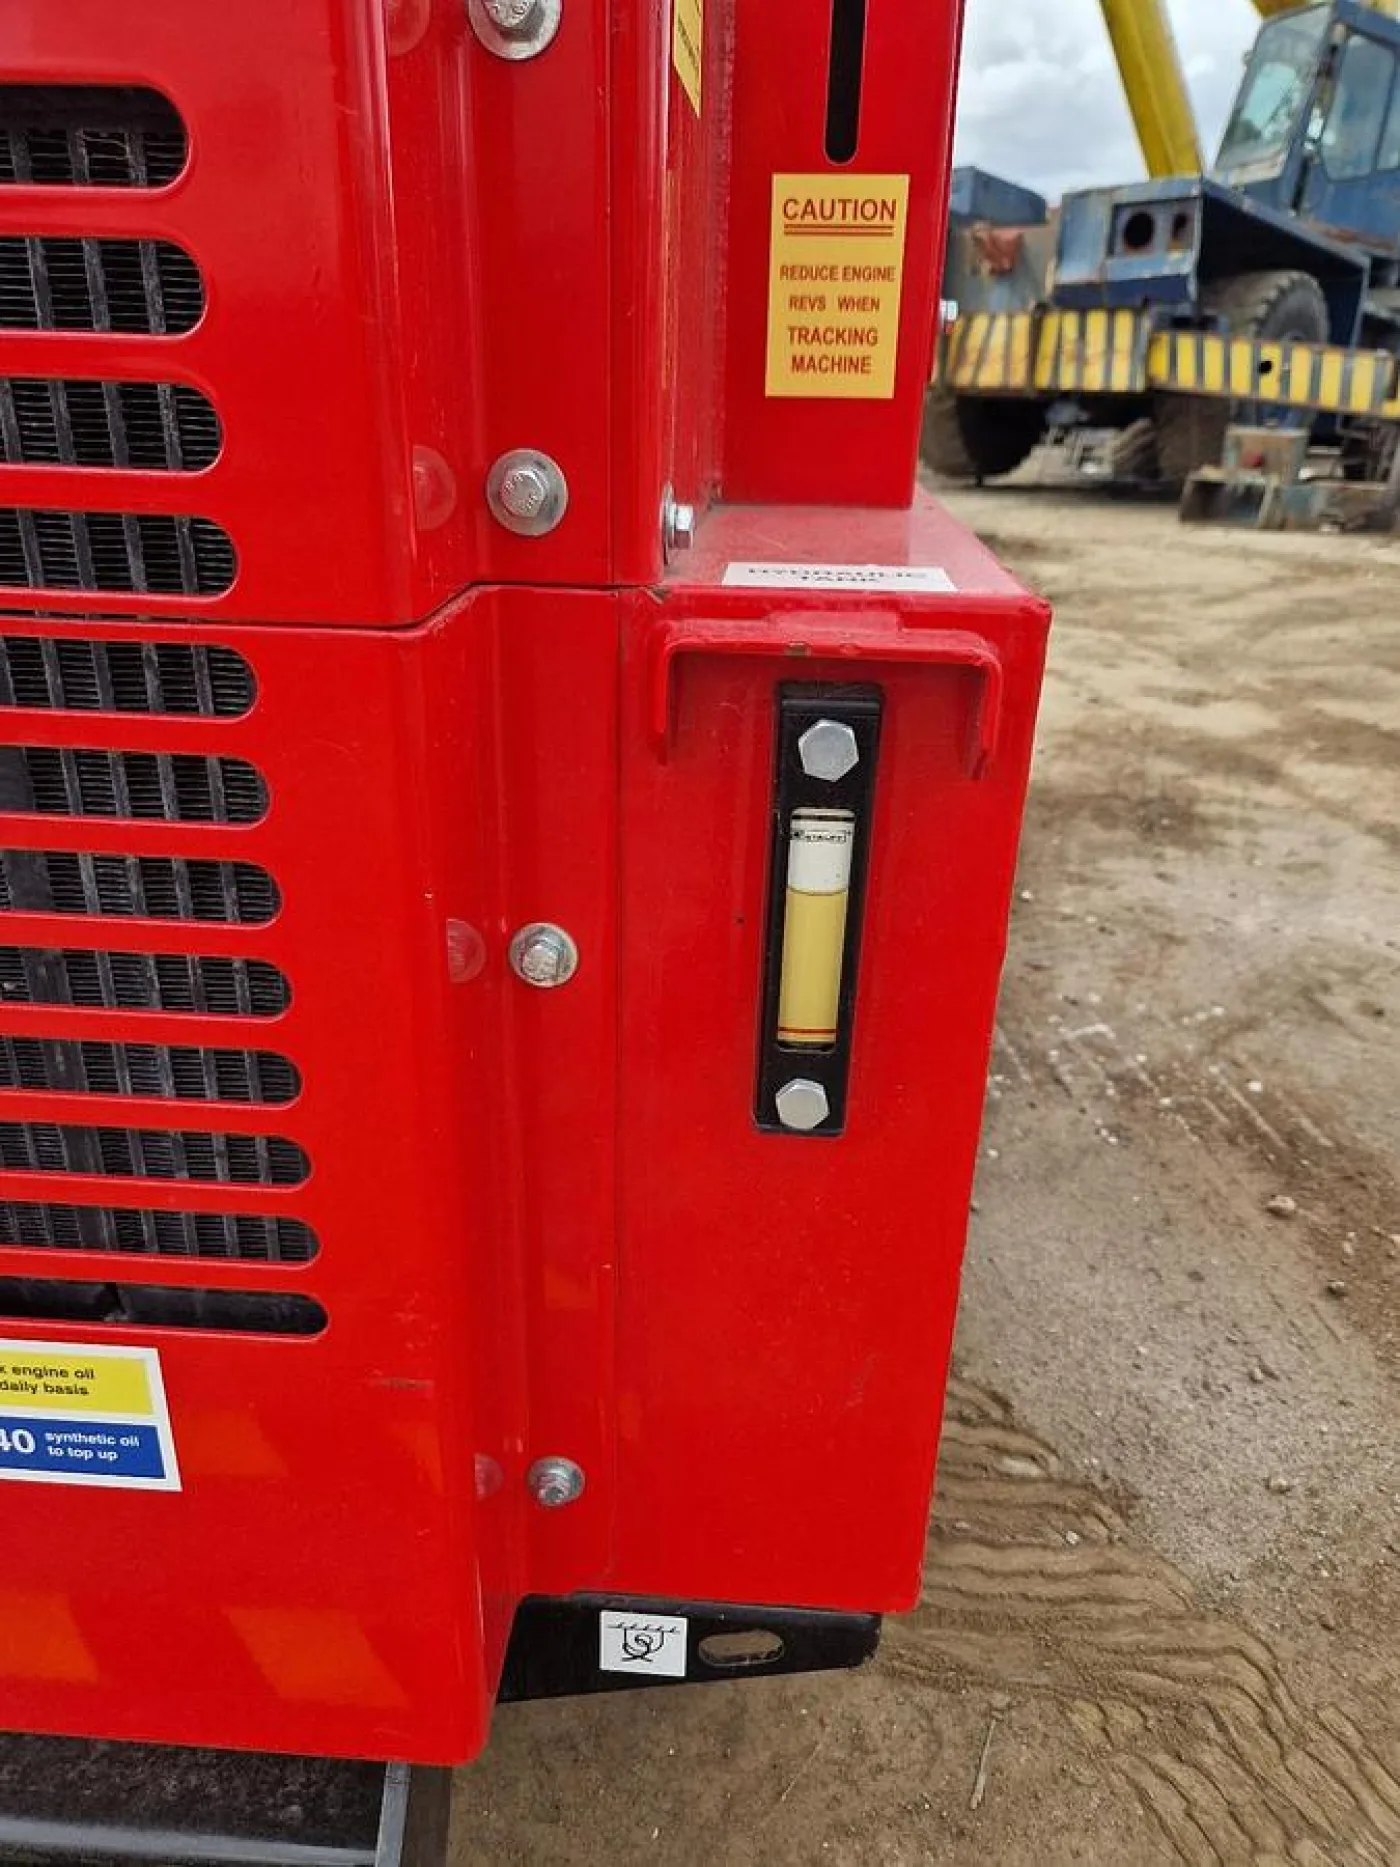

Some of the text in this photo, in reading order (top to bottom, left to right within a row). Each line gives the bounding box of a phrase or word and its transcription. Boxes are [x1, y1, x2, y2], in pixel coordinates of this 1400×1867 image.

[783, 198, 896, 222] CAUTION
[780, 264, 896, 282] REDUCE ENGINE
[788, 294, 880, 312] REVS WHEN
[787, 325, 878, 346] TRACKING
[791, 354, 872, 374] MACHINE
[12, 1366, 69, 1379] engine
[74, 1368, 95, 1380] oil
[43, 1383, 90, 1395] basis
[45, 1432, 140, 1447] synthetic oil
[47, 1446, 118, 1461] to top up
